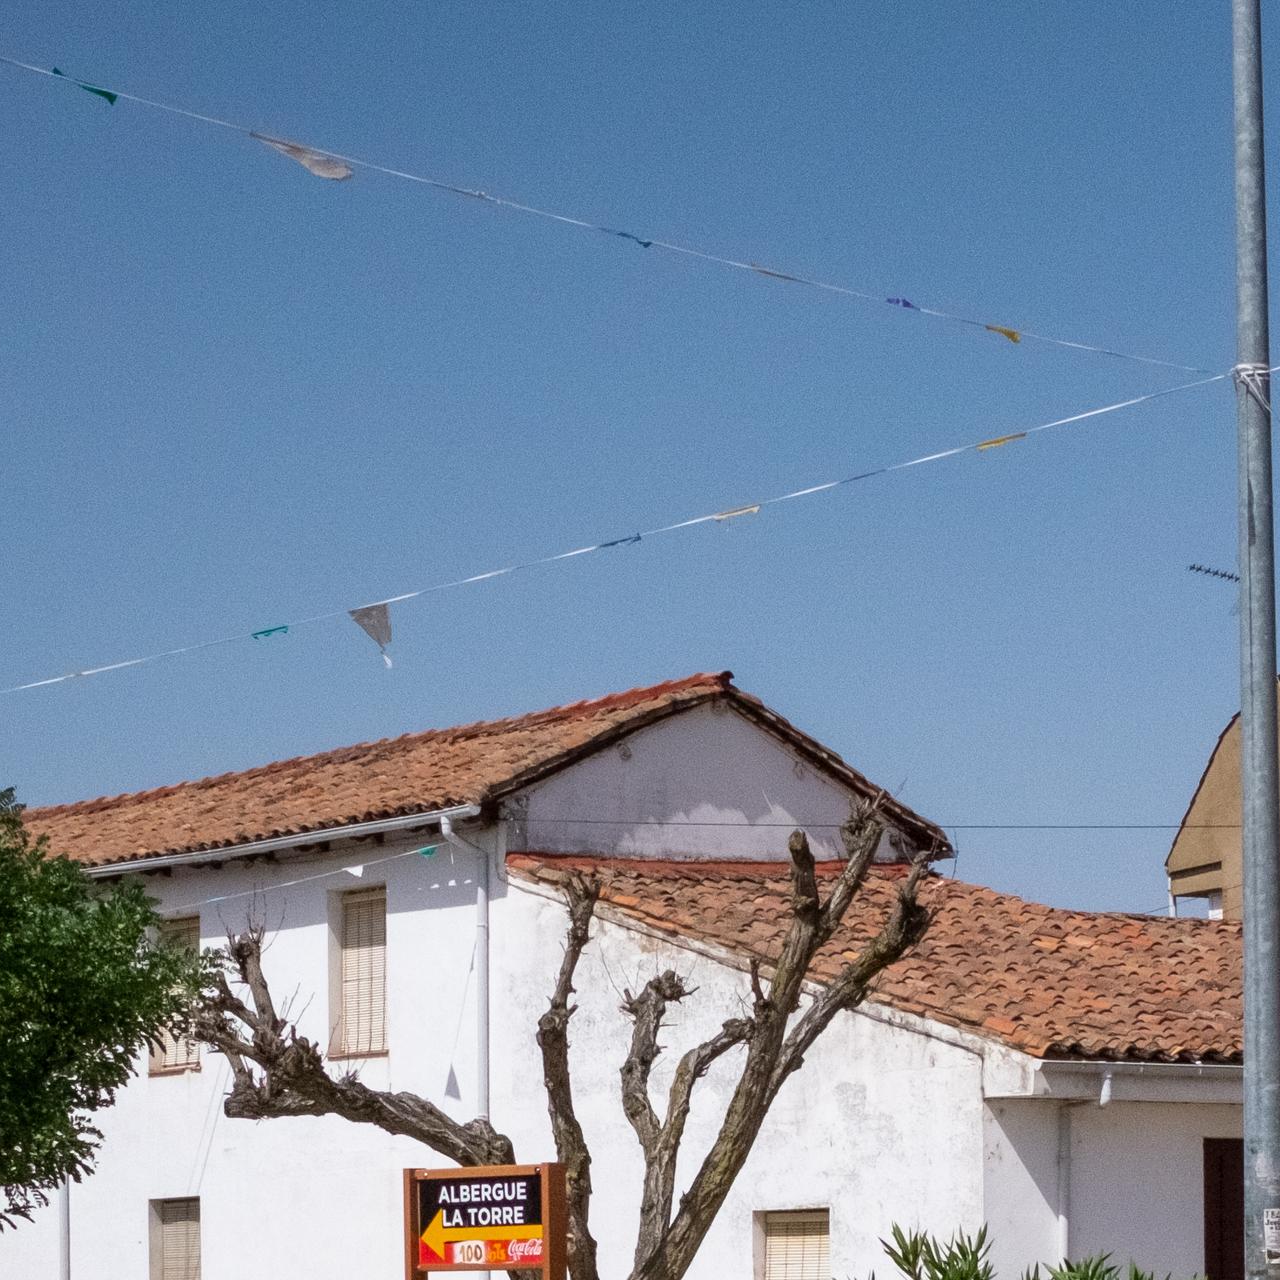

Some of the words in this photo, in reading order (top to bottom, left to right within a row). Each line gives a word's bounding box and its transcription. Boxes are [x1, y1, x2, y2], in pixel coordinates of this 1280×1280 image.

[439, 1182, 527, 1204] ALBERGUE
[442, 1208, 464, 1227] LA
[467, 1206, 525, 1226] TORRE
[460, 1244, 483, 1262] 100
